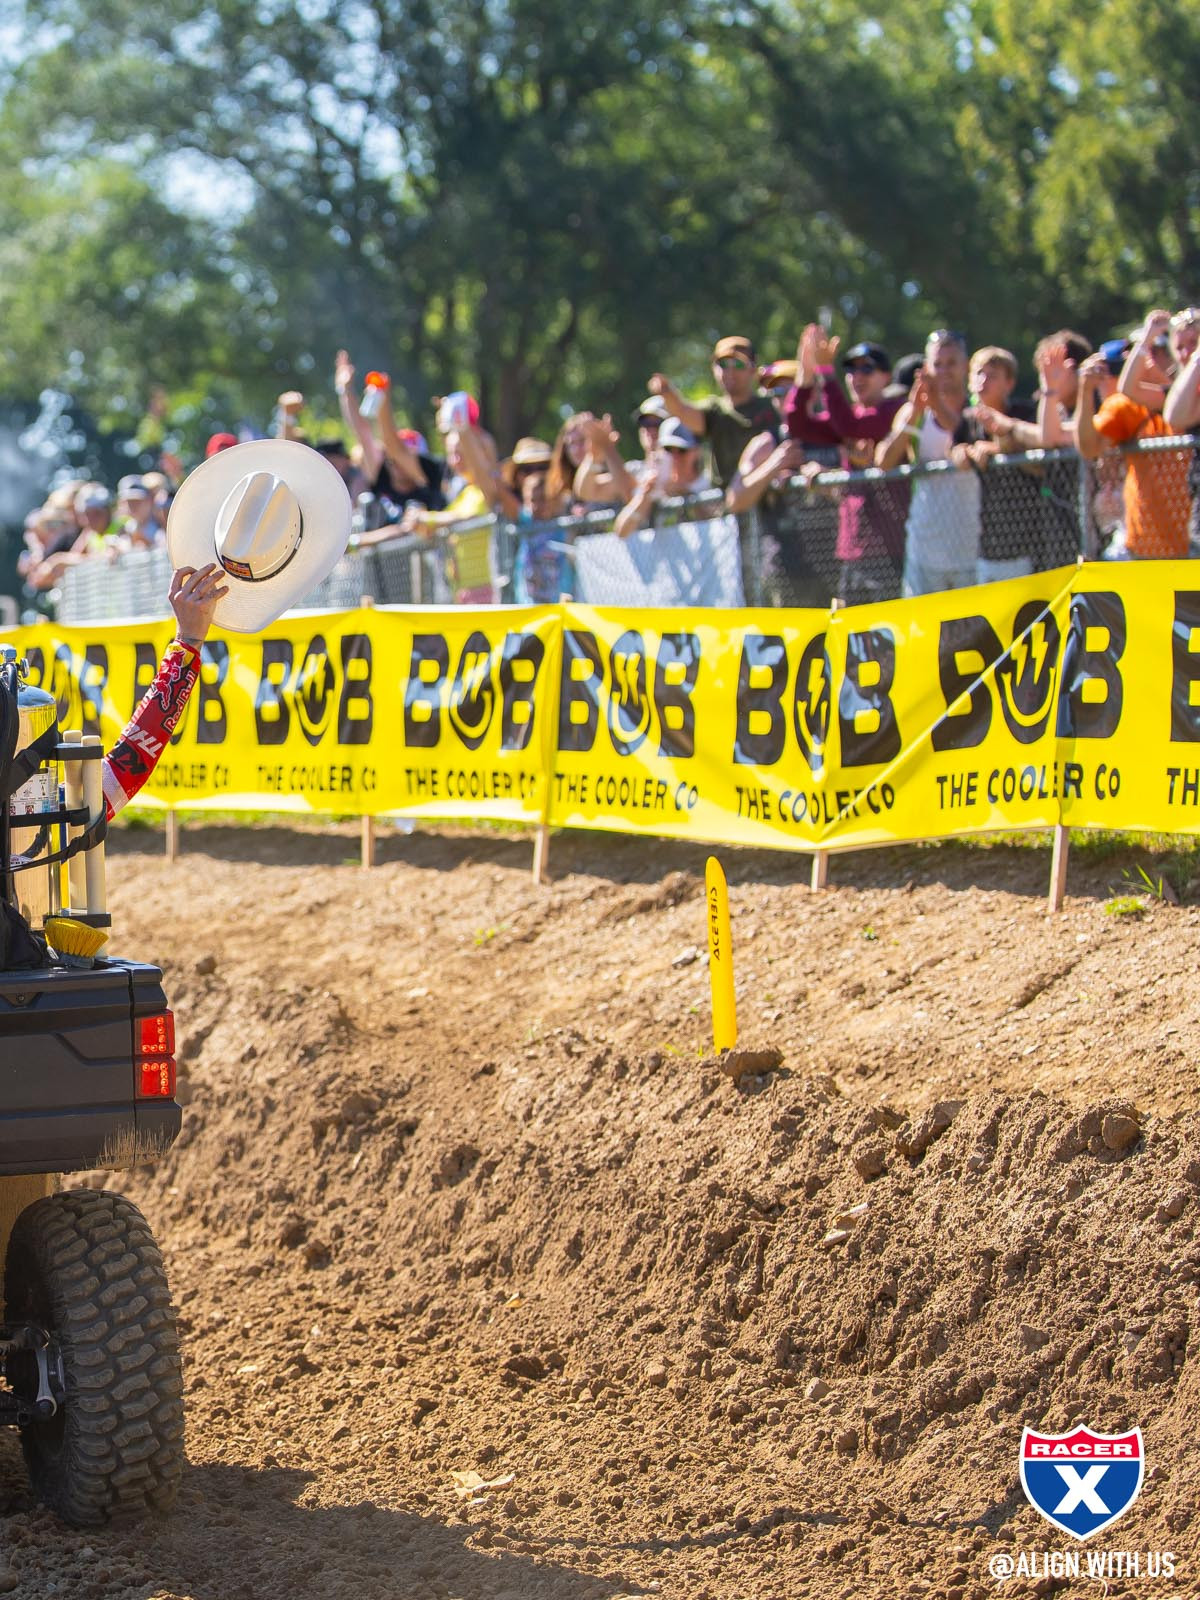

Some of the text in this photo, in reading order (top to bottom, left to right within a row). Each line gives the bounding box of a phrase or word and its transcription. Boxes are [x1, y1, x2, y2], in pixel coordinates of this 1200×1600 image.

[256, 633, 373, 746] BOB
[405, 631, 544, 751] BOB
[558, 629, 700, 758] BOB
[932, 592, 1126, 752] BOB
[733, 628, 901, 771] BOB
[290, 764, 353, 792] COOLER
[405, 768, 437, 796] THE
[447, 769, 512, 799] COOLER
[555, 773, 587, 803] THE
[595, 775, 668, 810] COOLER
[936, 772, 978, 809] THE
[987, 761, 1084, 804] COOLER
[1167, 767, 1200, 806] TH
[736, 785, 771, 820] THE
